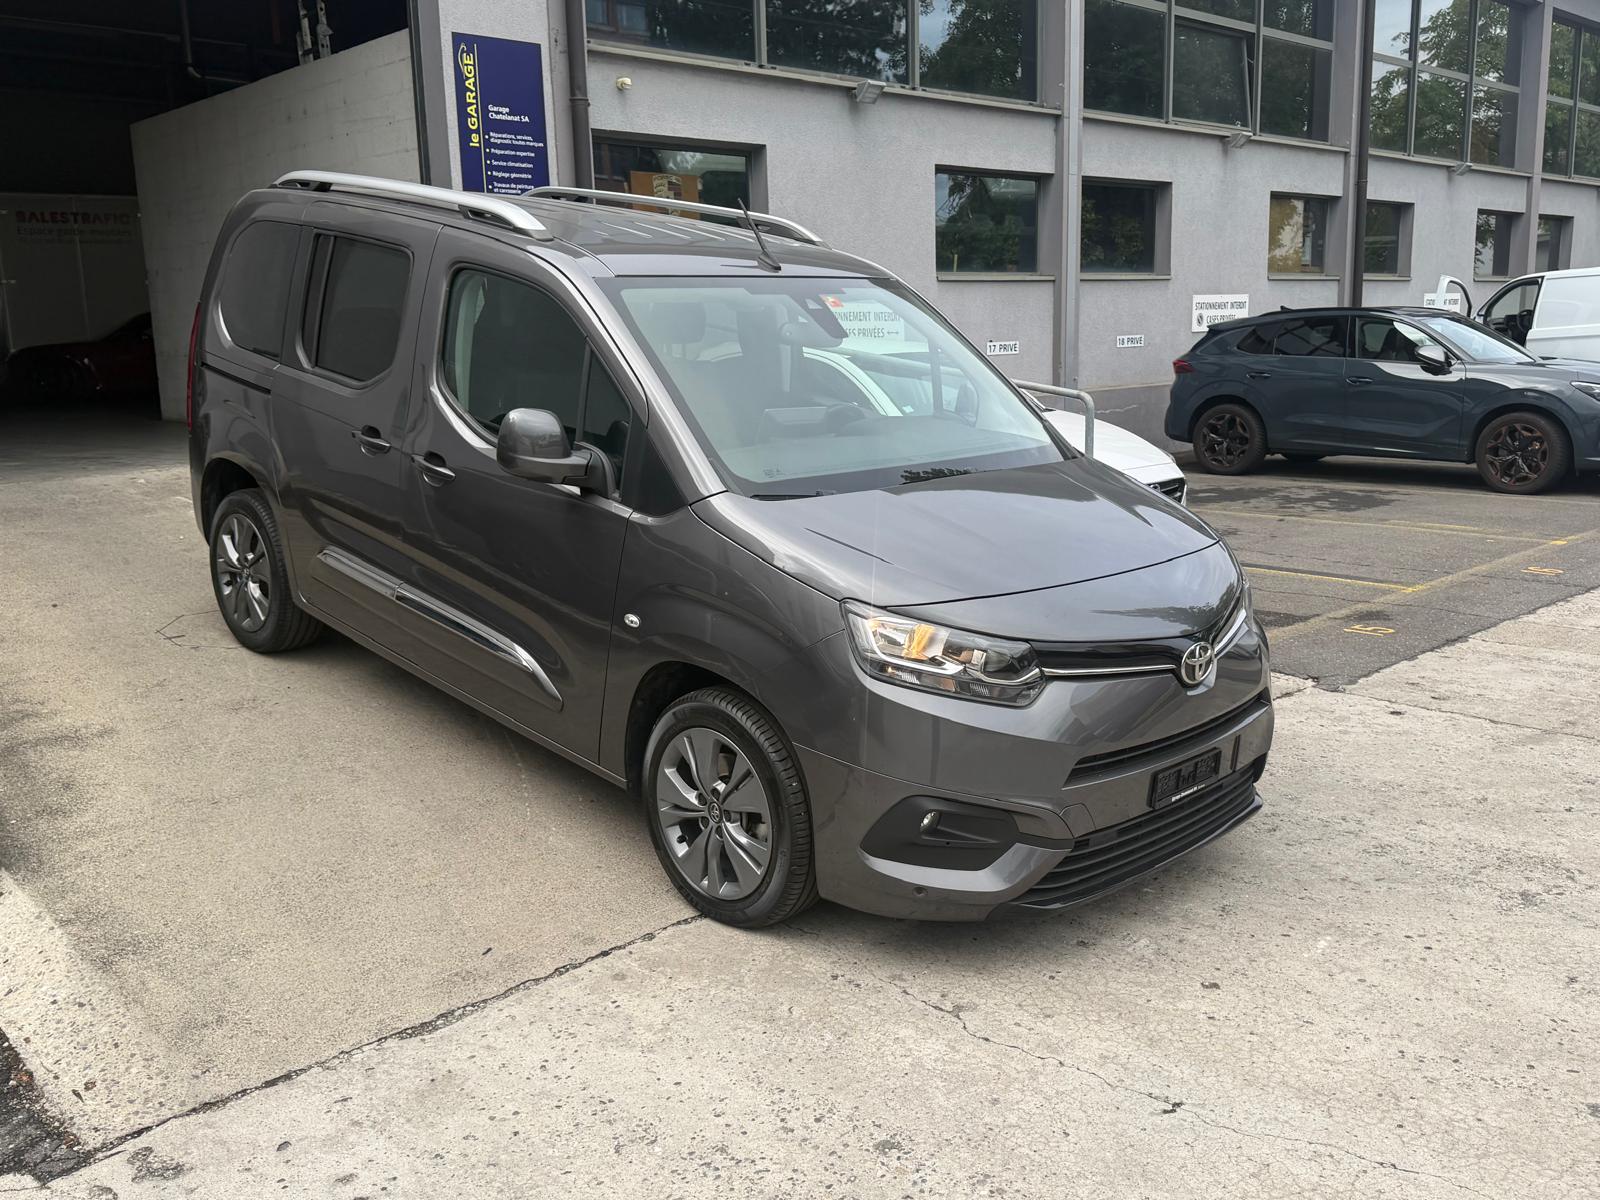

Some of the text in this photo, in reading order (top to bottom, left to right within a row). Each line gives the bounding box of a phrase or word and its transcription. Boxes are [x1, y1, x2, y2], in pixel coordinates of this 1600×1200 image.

[463, 53, 480, 147] le GARAGE
[488, 104, 510, 114] Garage
[521, 115, 530, 123] SA
[1195, 300, 1247, 311] STATIONNEMENT INTERDIT
[1118, 337, 1125, 346] 18
[988, 344, 997, 353] 17
[1343, 624, 1396, 637] 15
